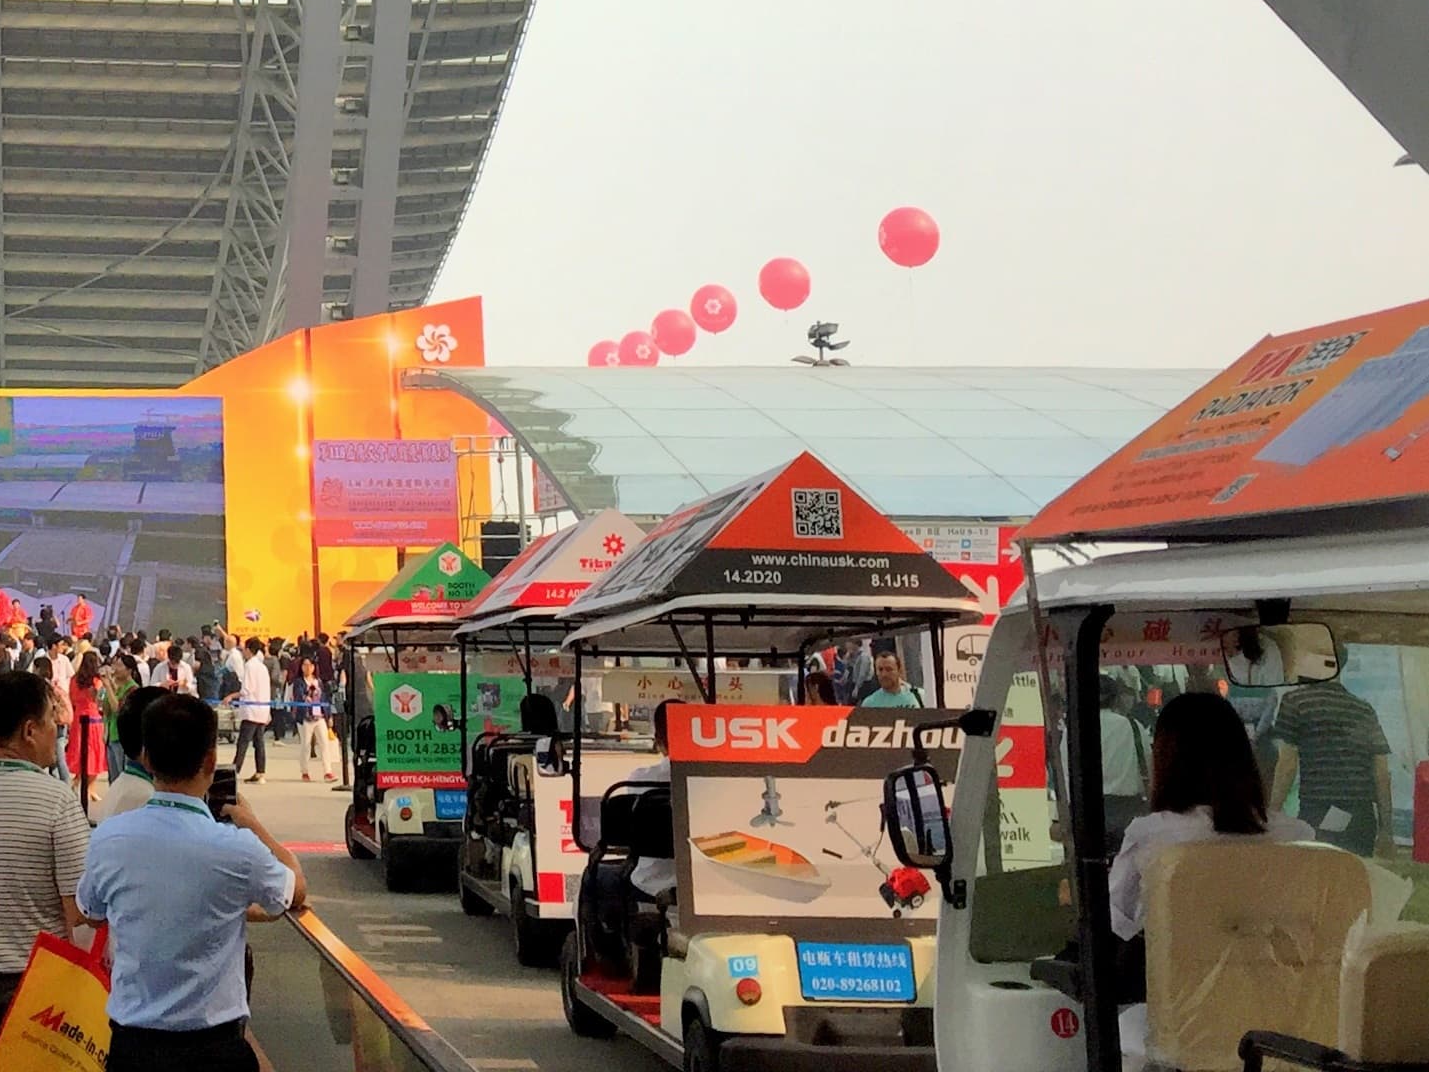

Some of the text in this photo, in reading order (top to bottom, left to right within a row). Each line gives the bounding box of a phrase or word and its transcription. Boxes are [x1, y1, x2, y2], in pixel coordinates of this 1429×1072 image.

[751, 554, 890, 569] www.chinausk.com
[723, 570, 920, 588] 14.2D20 8.1J15
[386, 729, 433, 741] BOOTH
[691, 717, 802, 750] USK
[732, 958, 757, 972] 09
[812, 977, 901, 993] 020-89268102
